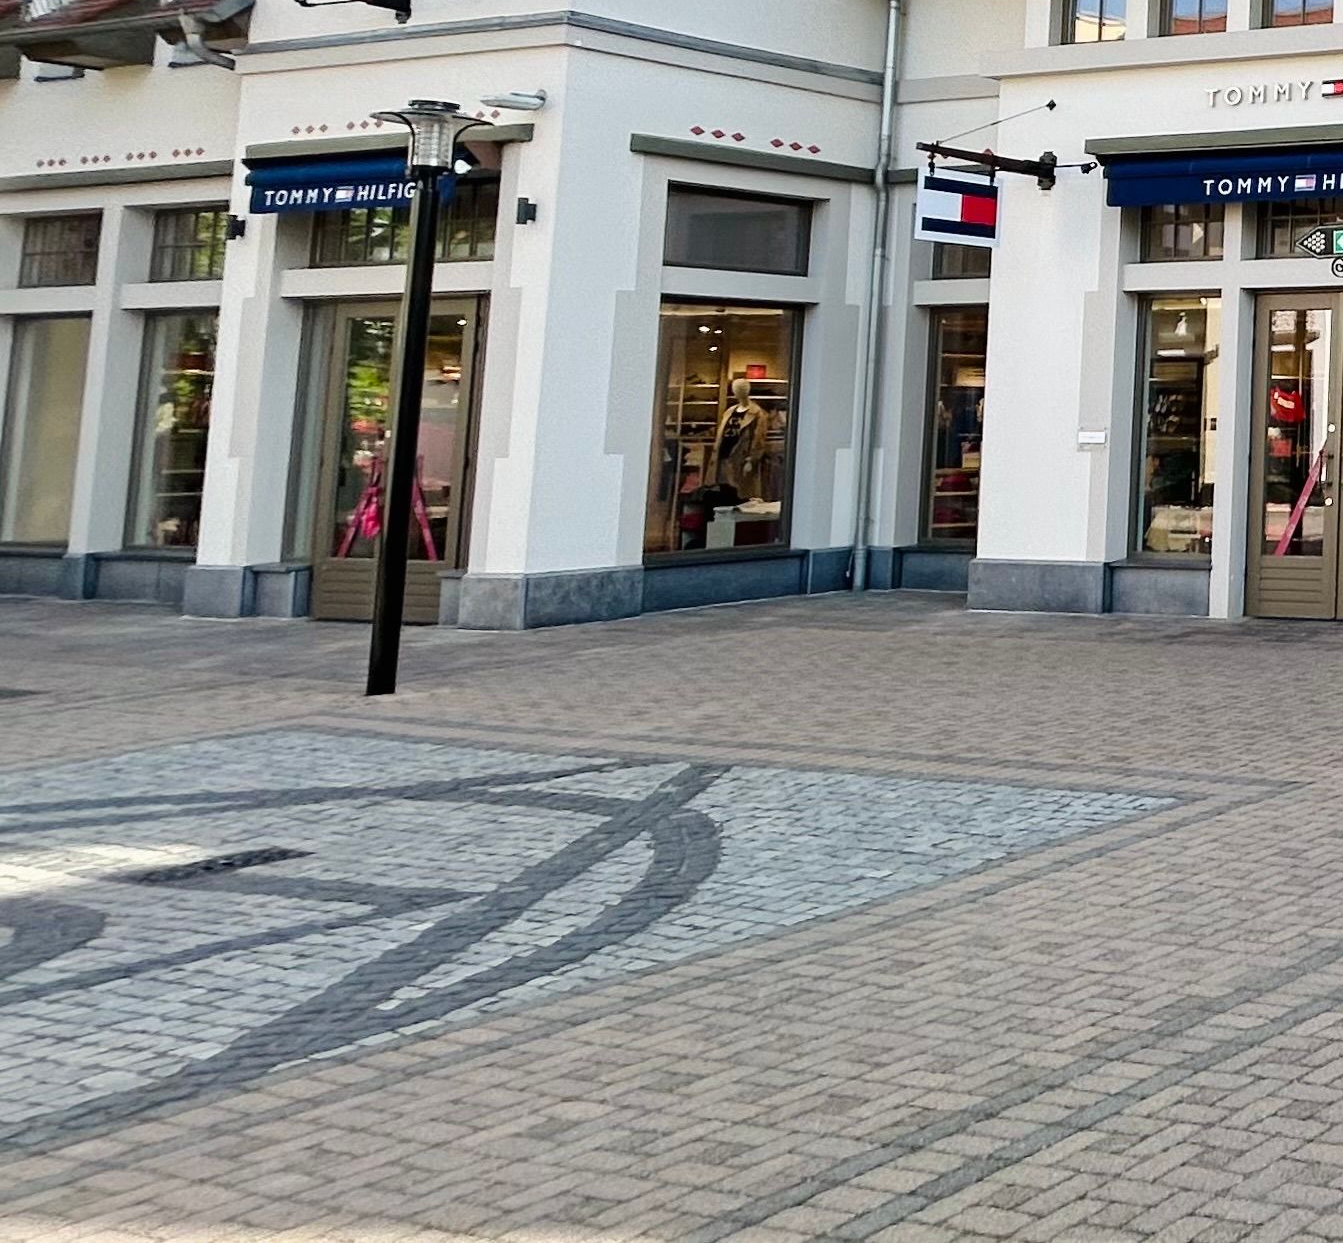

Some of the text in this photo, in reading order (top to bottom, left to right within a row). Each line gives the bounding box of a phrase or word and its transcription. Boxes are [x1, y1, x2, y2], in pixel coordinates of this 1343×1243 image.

[1205, 80, 1314, 107] TOMMY
[264, 181, 417, 206] TOMMY HILFIG
[1203, 175, 1290, 196] TOMMY
